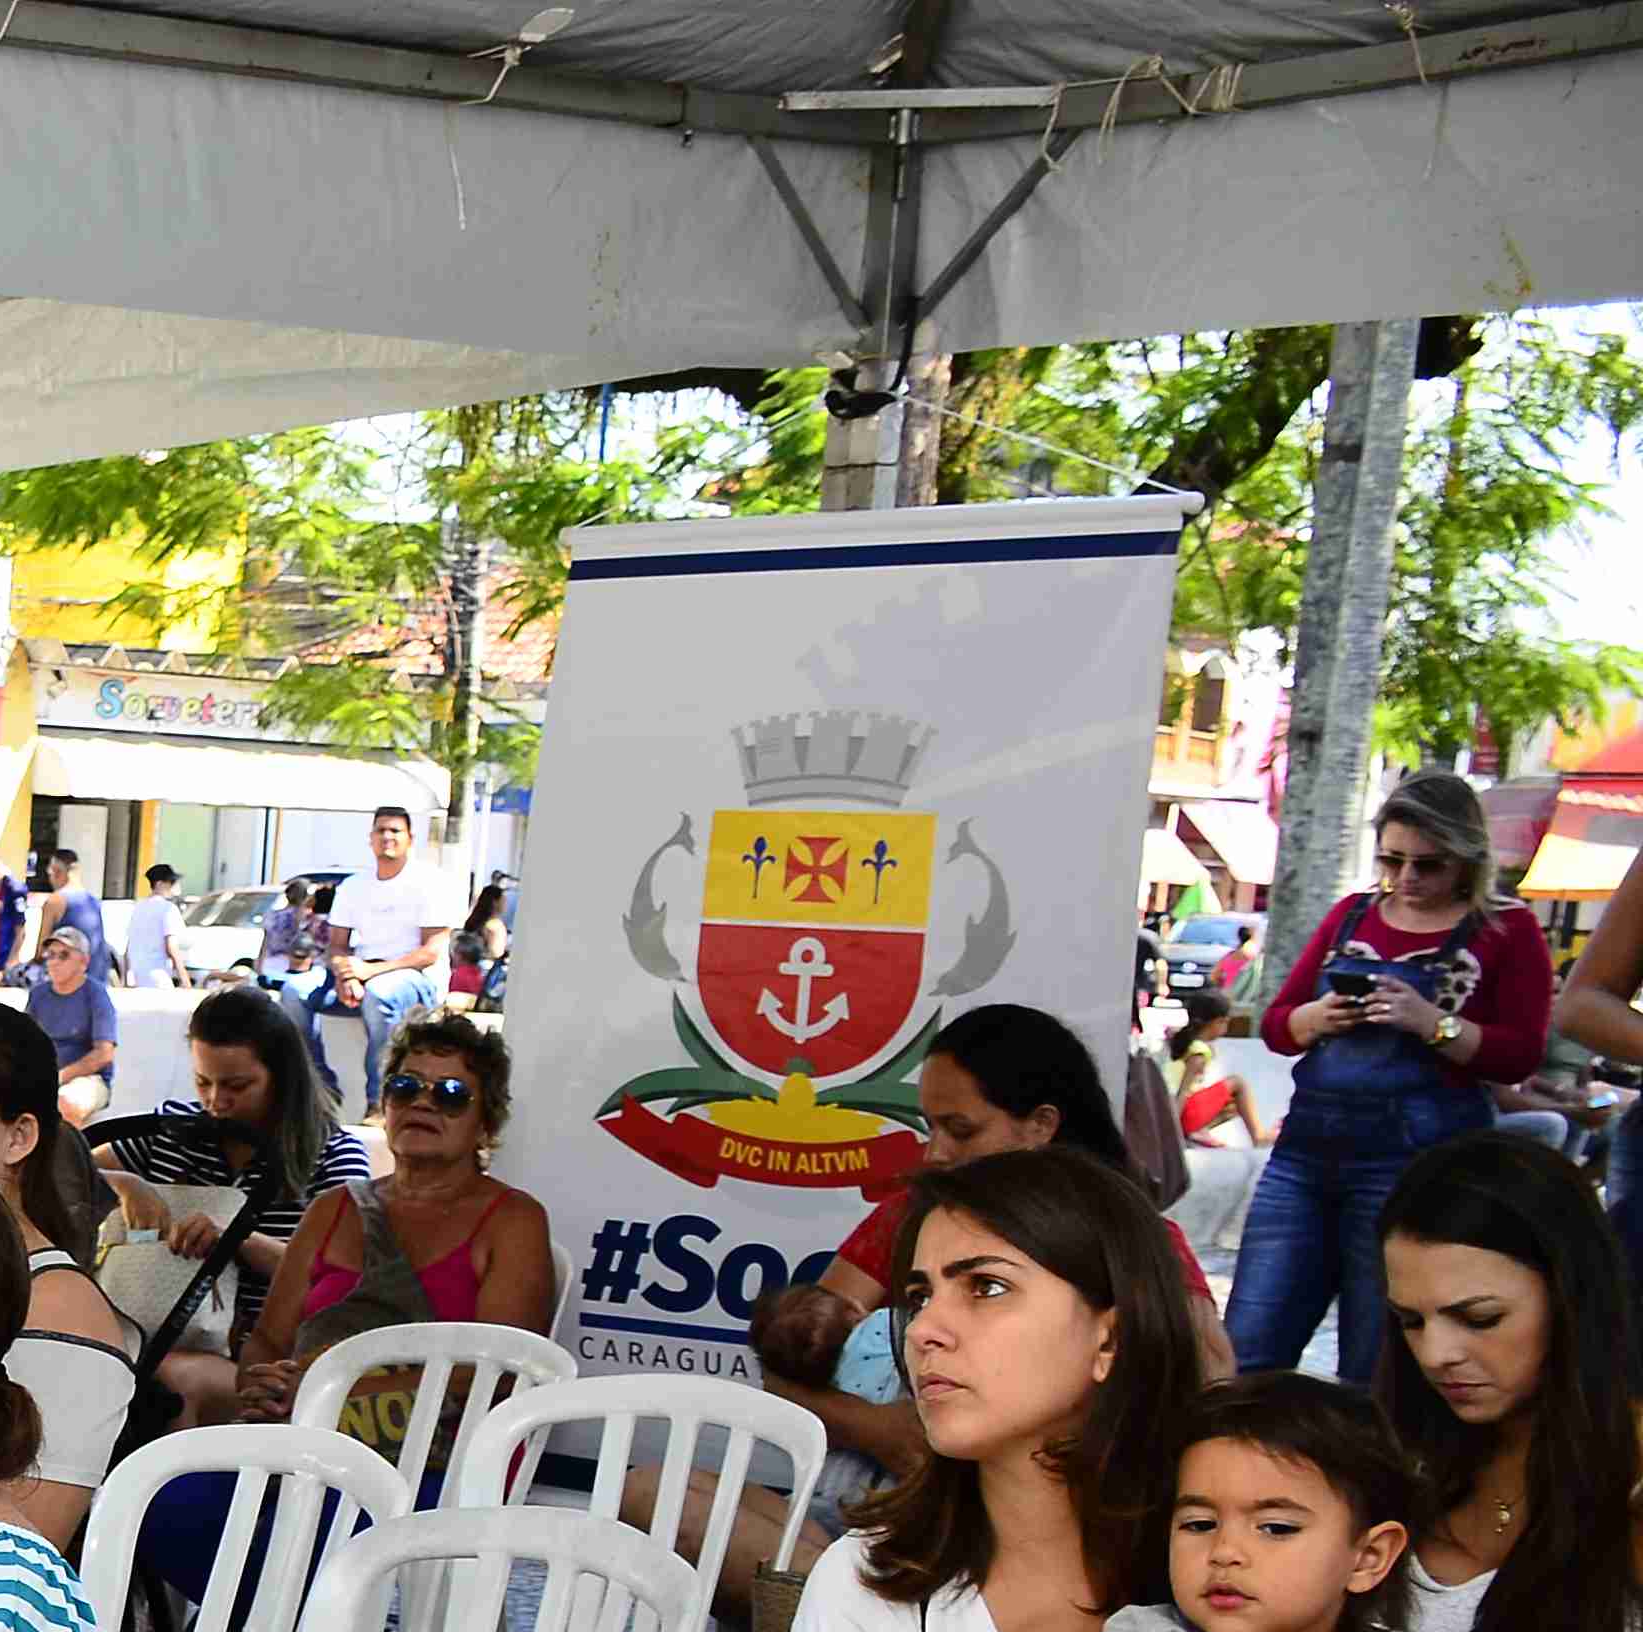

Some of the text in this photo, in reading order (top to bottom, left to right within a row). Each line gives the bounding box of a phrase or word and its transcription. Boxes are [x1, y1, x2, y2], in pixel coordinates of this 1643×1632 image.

[718, 1136, 871, 1175] DVC IN ALTVM
